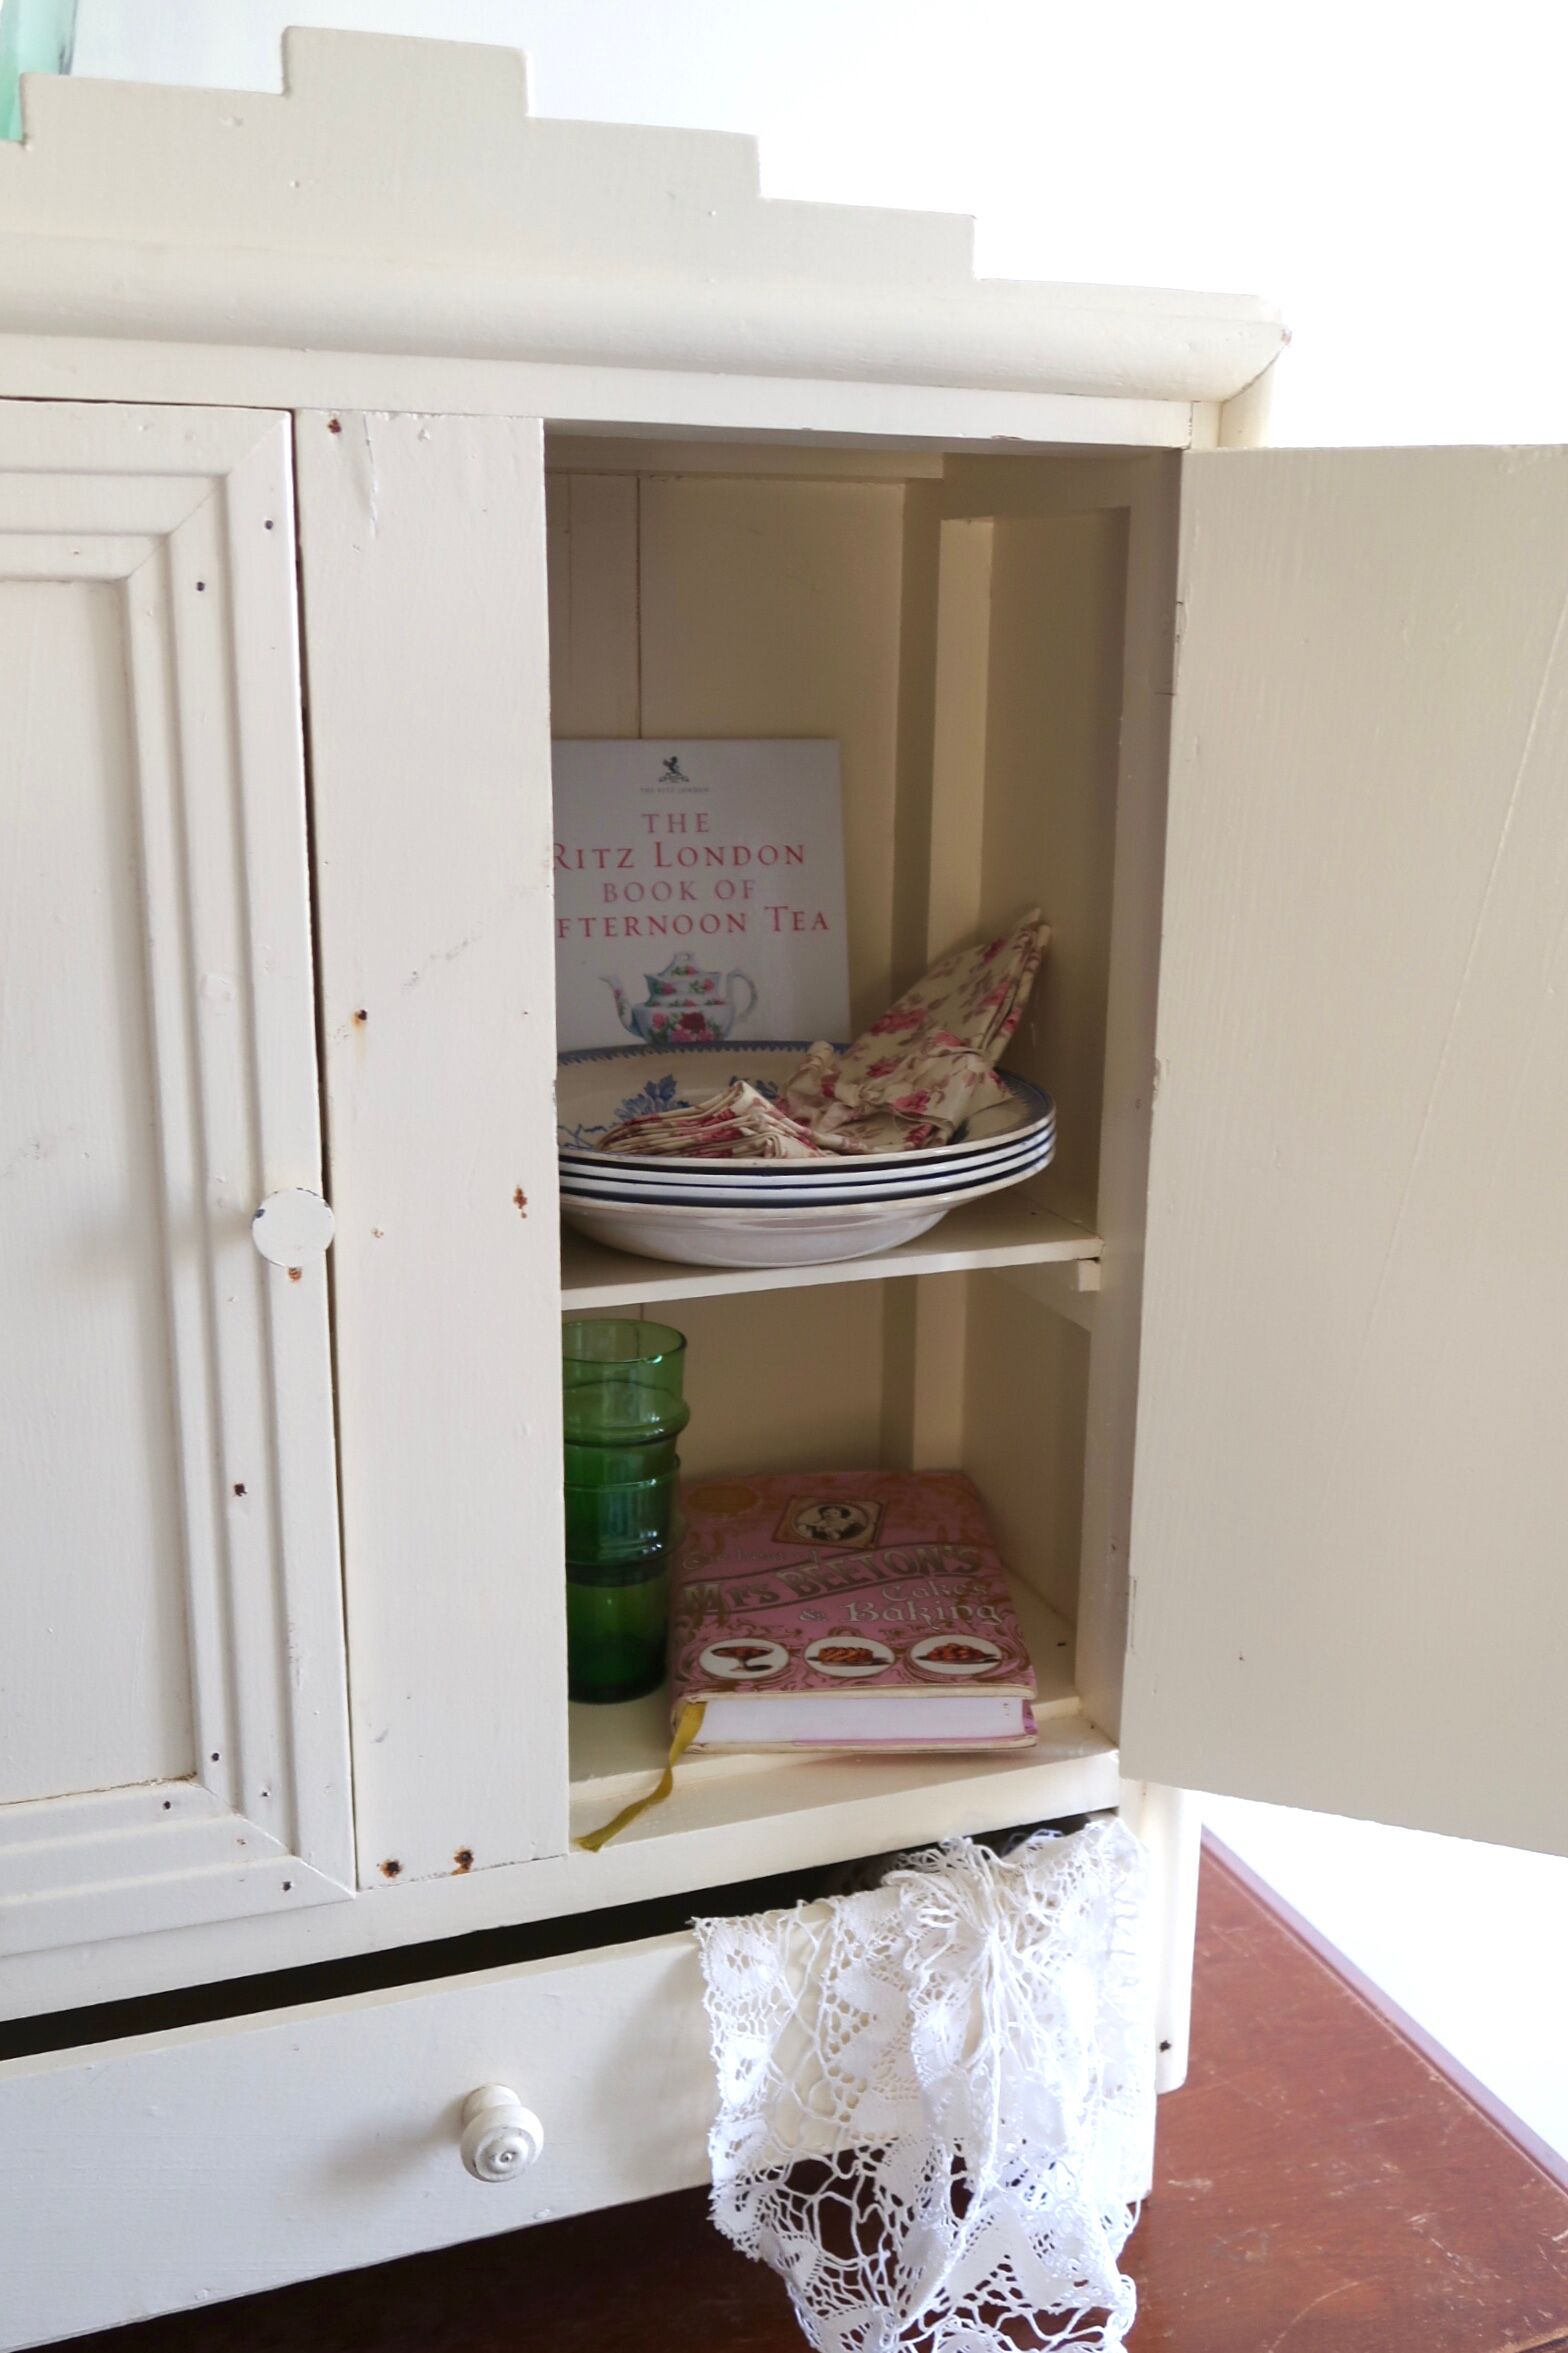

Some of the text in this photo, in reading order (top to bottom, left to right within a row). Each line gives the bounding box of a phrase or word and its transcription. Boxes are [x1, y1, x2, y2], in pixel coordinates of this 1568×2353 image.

[641, 812, 710, 834] THE
[553, 841, 806, 871] RITZ LONDON
[602, 878, 756, 904] BOOK OF
[556, 904, 831, 939] FTERNOON TEA
[881, 1577, 988, 1602] Cakes
[799, 1600, 1003, 1632] & Baking
